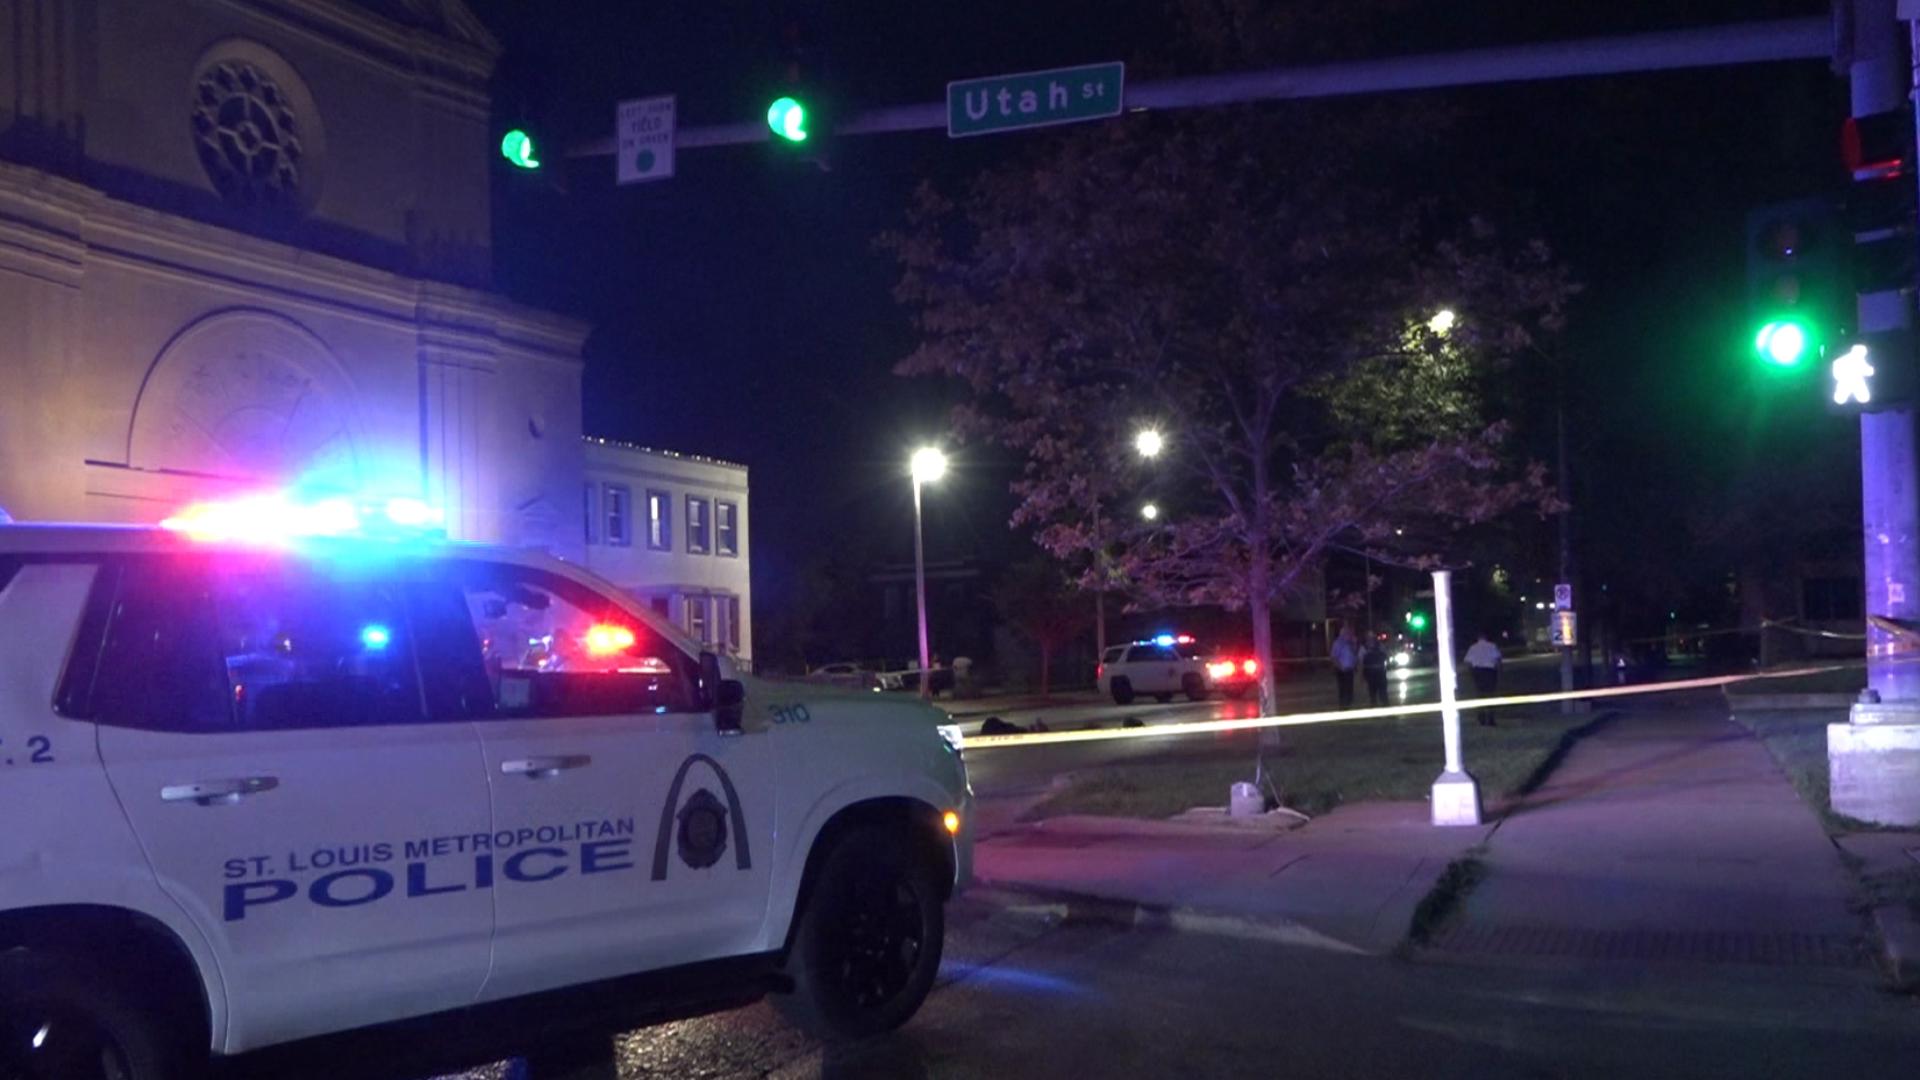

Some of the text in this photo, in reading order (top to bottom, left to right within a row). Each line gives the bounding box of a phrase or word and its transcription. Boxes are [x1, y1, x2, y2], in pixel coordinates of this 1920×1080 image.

[965, 81, 1069, 120] Utah
[631, 116, 662, 132] YIELD
[768, 703, 810, 724] 310
[27, 735, 55, 763] 2
[224, 817, 635, 879] ST. LOUIS METROPOLITAN
[224, 838, 635, 922] POLICE
